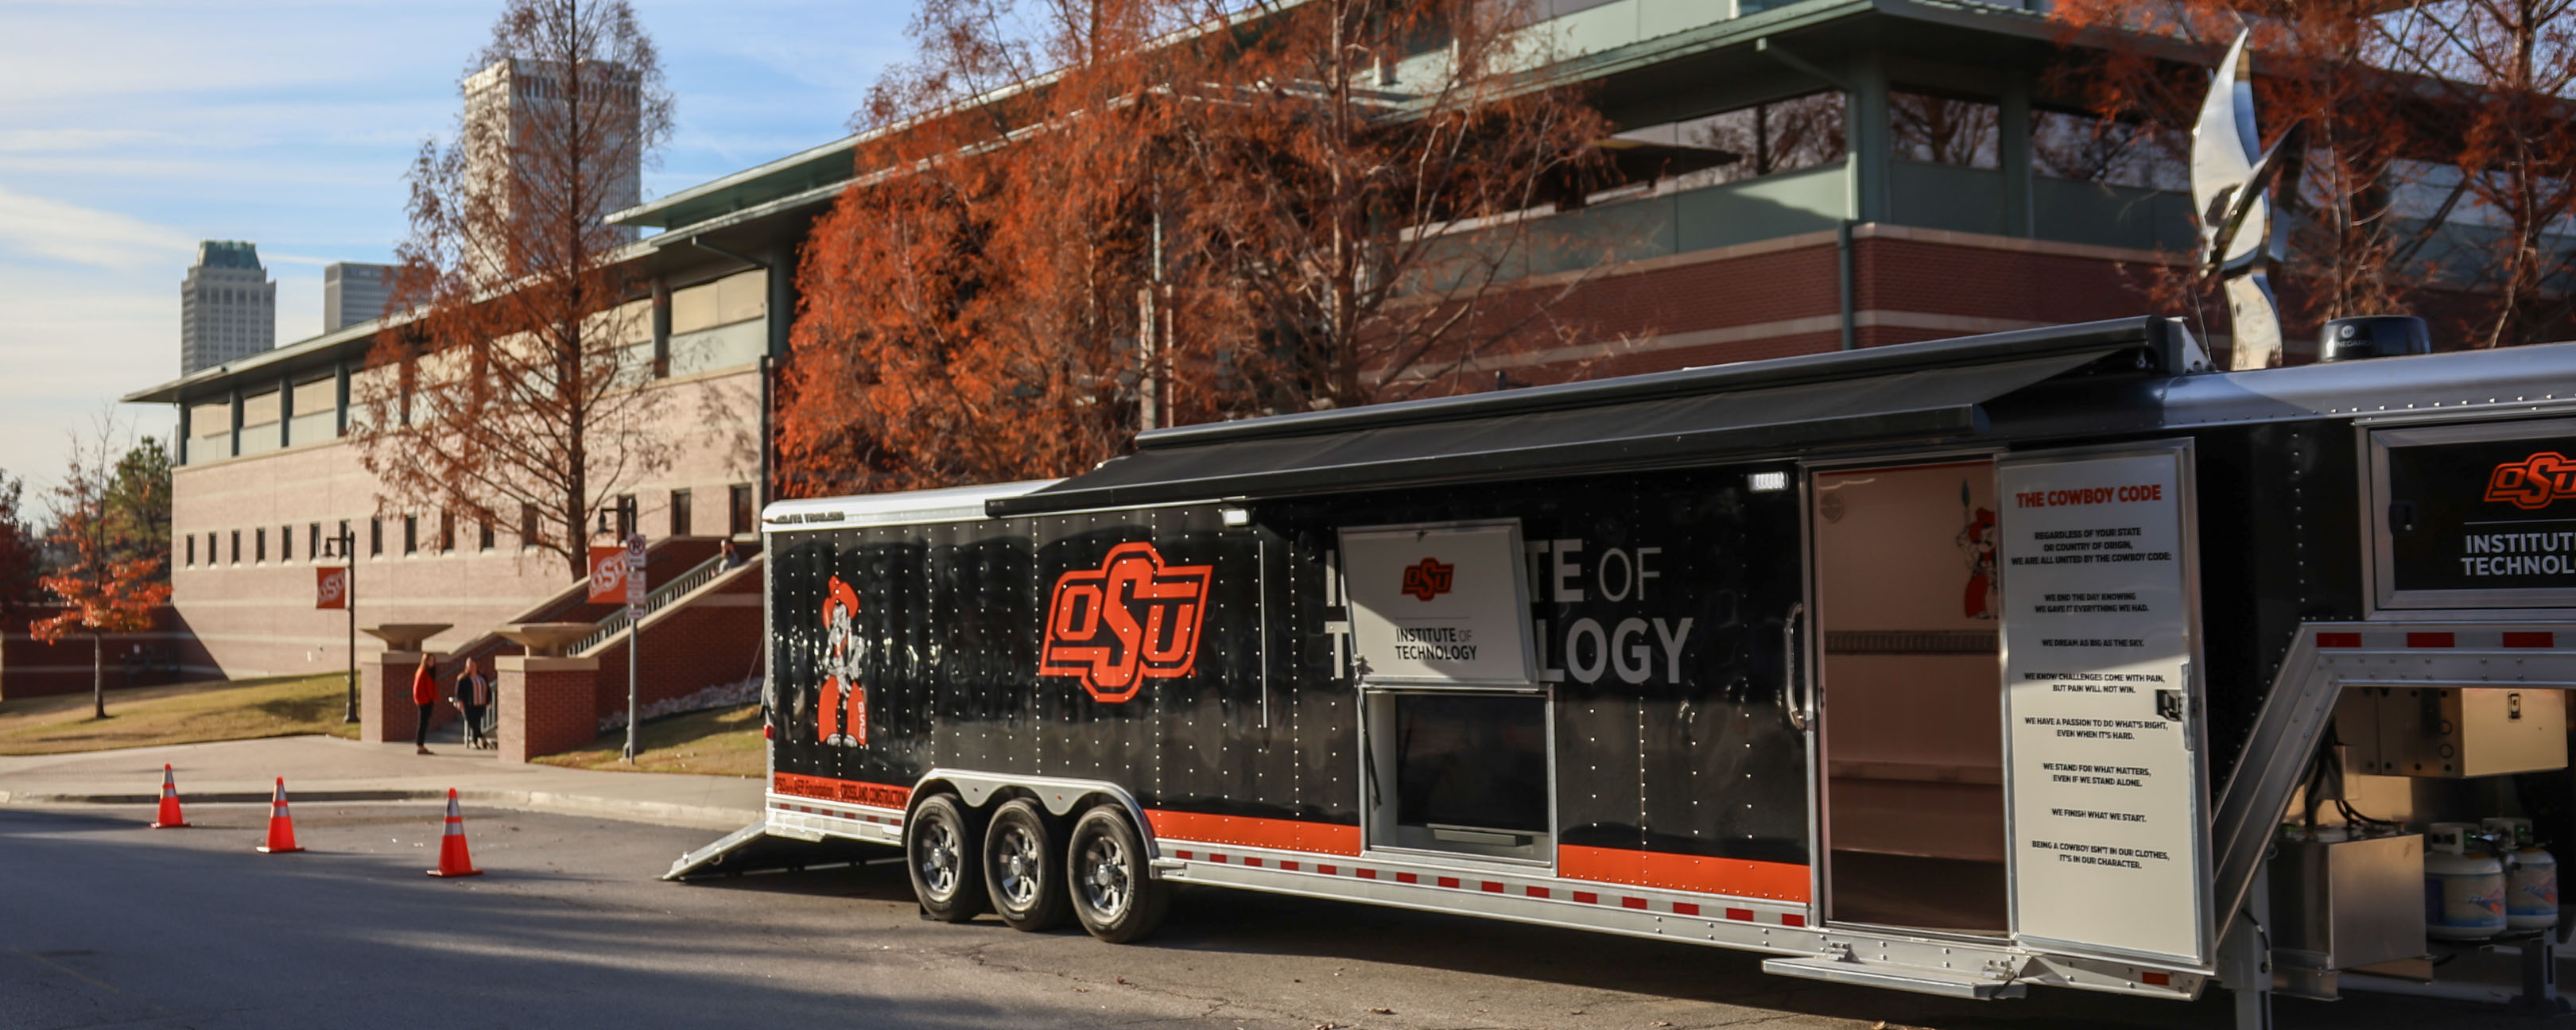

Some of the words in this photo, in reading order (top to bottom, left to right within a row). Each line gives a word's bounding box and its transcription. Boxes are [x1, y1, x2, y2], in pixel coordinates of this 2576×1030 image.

[2326, 339, 2372, 348] INEGARD
[2016, 491, 2044, 508] THE
[2047, 487, 2115, 506] COWBOY
[2118, 484, 2162, 502] CODE
[2035, 530, 2082, 540] REGARDLESS
[2095, 529, 2116, 537] YOUR
[2056, 543, 2090, 552] COUNTRY
[2104, 540, 2132, 550] ORIGIN,
[2465, 532, 2576, 554] INSTITUT
[2055, 556, 2082, 564] UNITED
[2112, 553, 2147, 562] COWBOY
[2148, 552, 2171, 561] CODE:
[2462, 556, 2576, 576] TECHNOL
[589, 552, 628, 598] OSU
[1401, 557, 1456, 602] OSU
[1599, 547, 1662, 602] OF
[1039, 541, 1213, 703] OSU
[1396, 628, 1457, 643] INSTITUTE
[1459, 629, 1472, 642] OF
[1395, 645, 1477, 660] TECHNOLOGY
[2115, 720, 2143, 729] WHAT'S
[2144, 722, 2168, 730] RIGHT,
[2116, 766, 2151, 776] MATTERS,
[2116, 778, 2142, 787] ALONE.
[2123, 813, 2147, 823] START.
[2032, 840, 2052, 849] BEING
[2060, 842, 2089, 852] COWBOY
[2119, 847, 2134, 856] OUR
[2135, 849, 2169, 861] CLOTHES,
[2097, 858, 2142, 869] CHARACTER.
